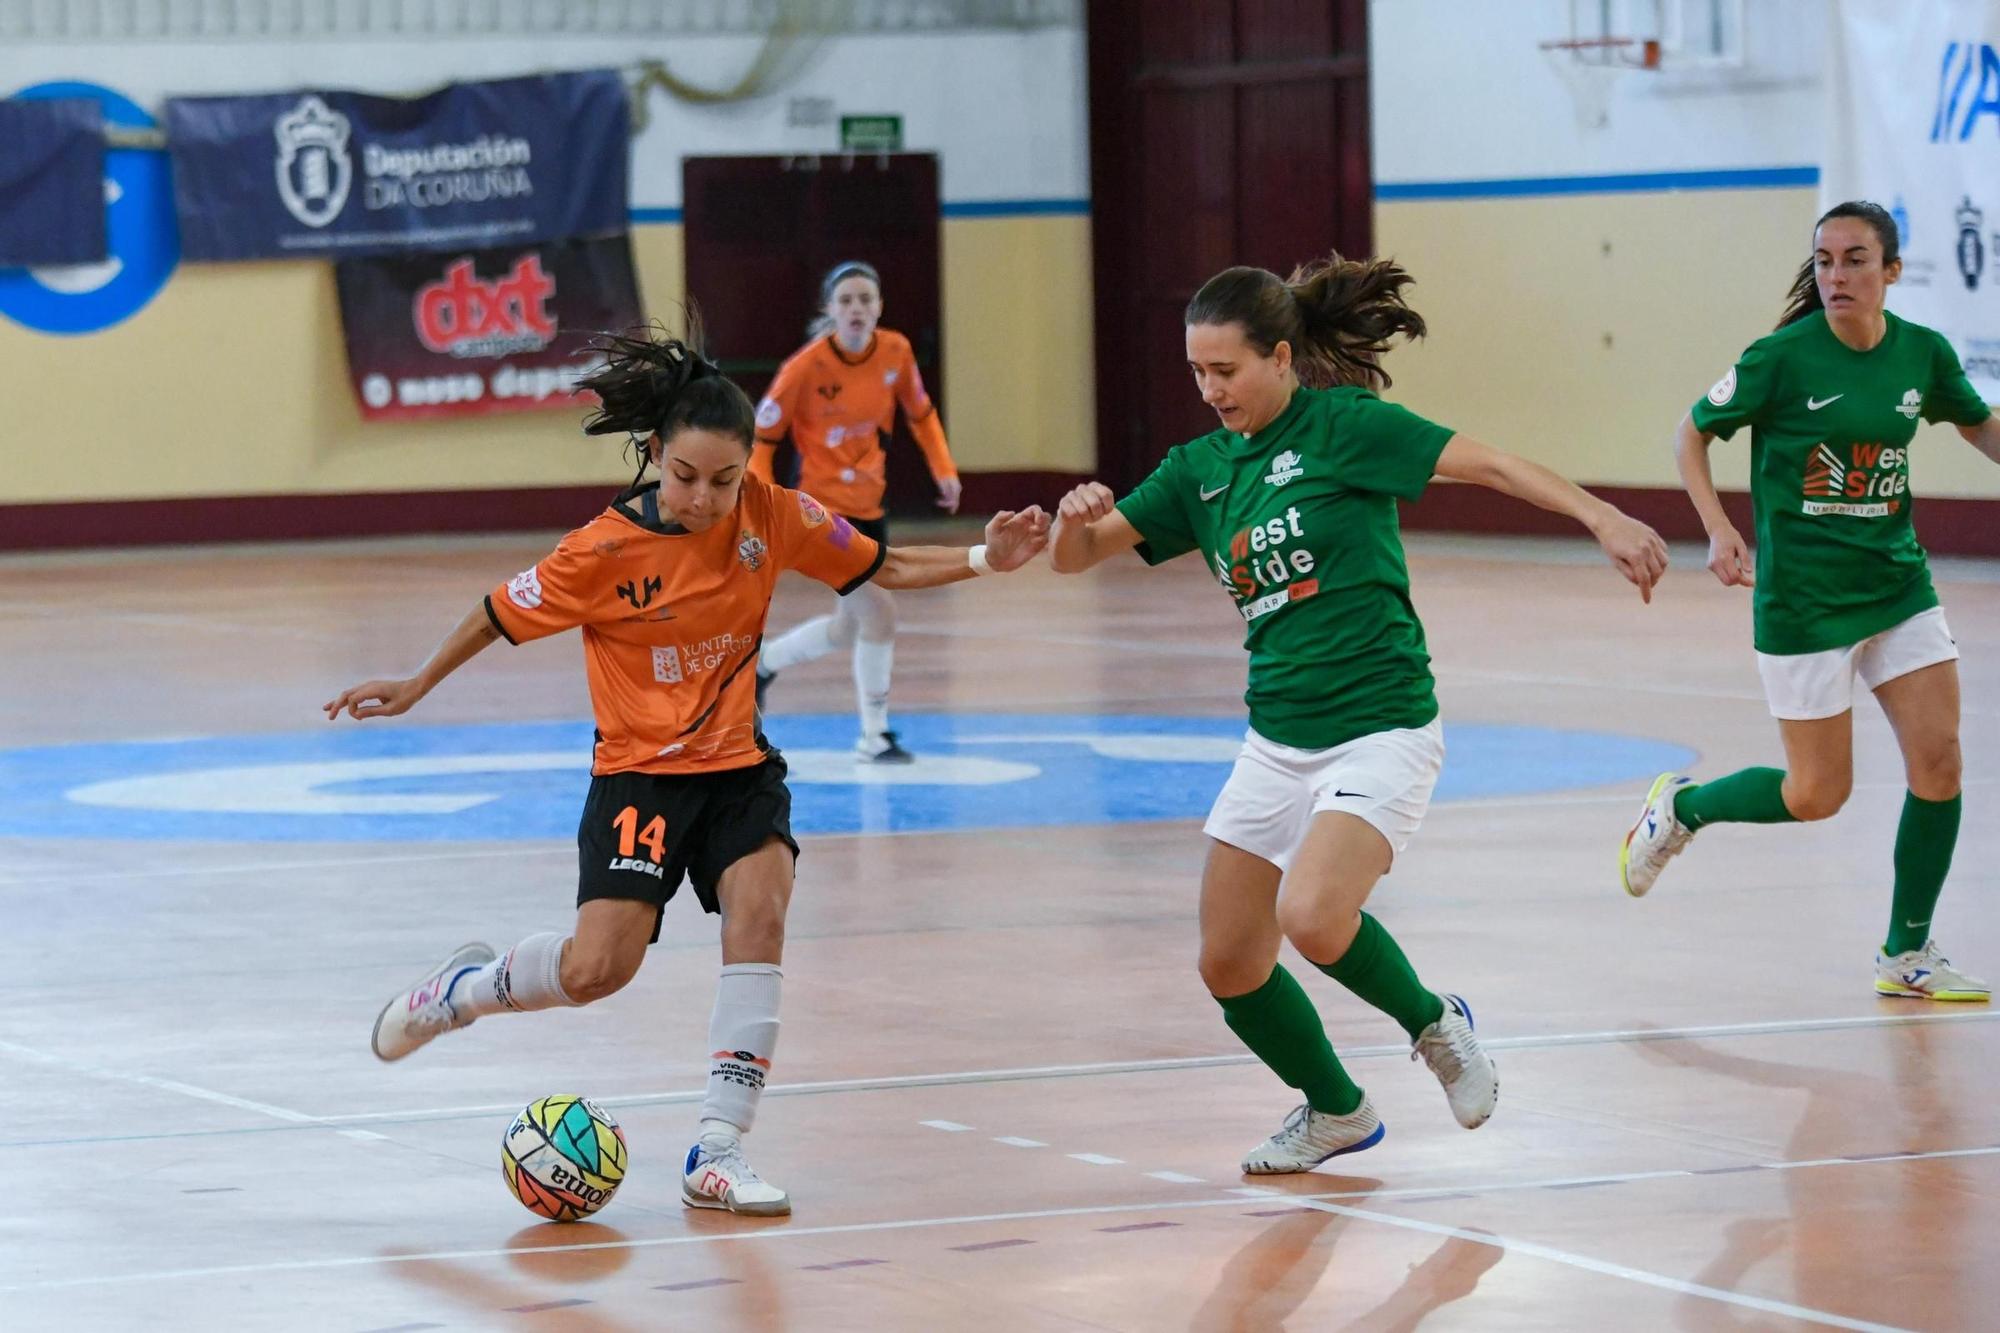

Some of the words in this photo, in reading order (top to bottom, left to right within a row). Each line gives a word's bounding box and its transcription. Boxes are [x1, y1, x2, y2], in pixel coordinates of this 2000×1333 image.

[363, 135, 531, 182] Deputación
[405, 166, 533, 208] CORUÑA
[415, 254, 556, 351] dxt
[1852, 442, 1906, 469] Wes
[1845, 470, 1906, 497] Side
[1231, 549, 1315, 597] Side
[681, 633, 733, 660] XUNTA
[685, 658, 702, 675] DE
[612, 805, 667, 865] 14
[608, 857, 664, 880] LEGEA
[720, 1063, 764, 1079] VIAJES
